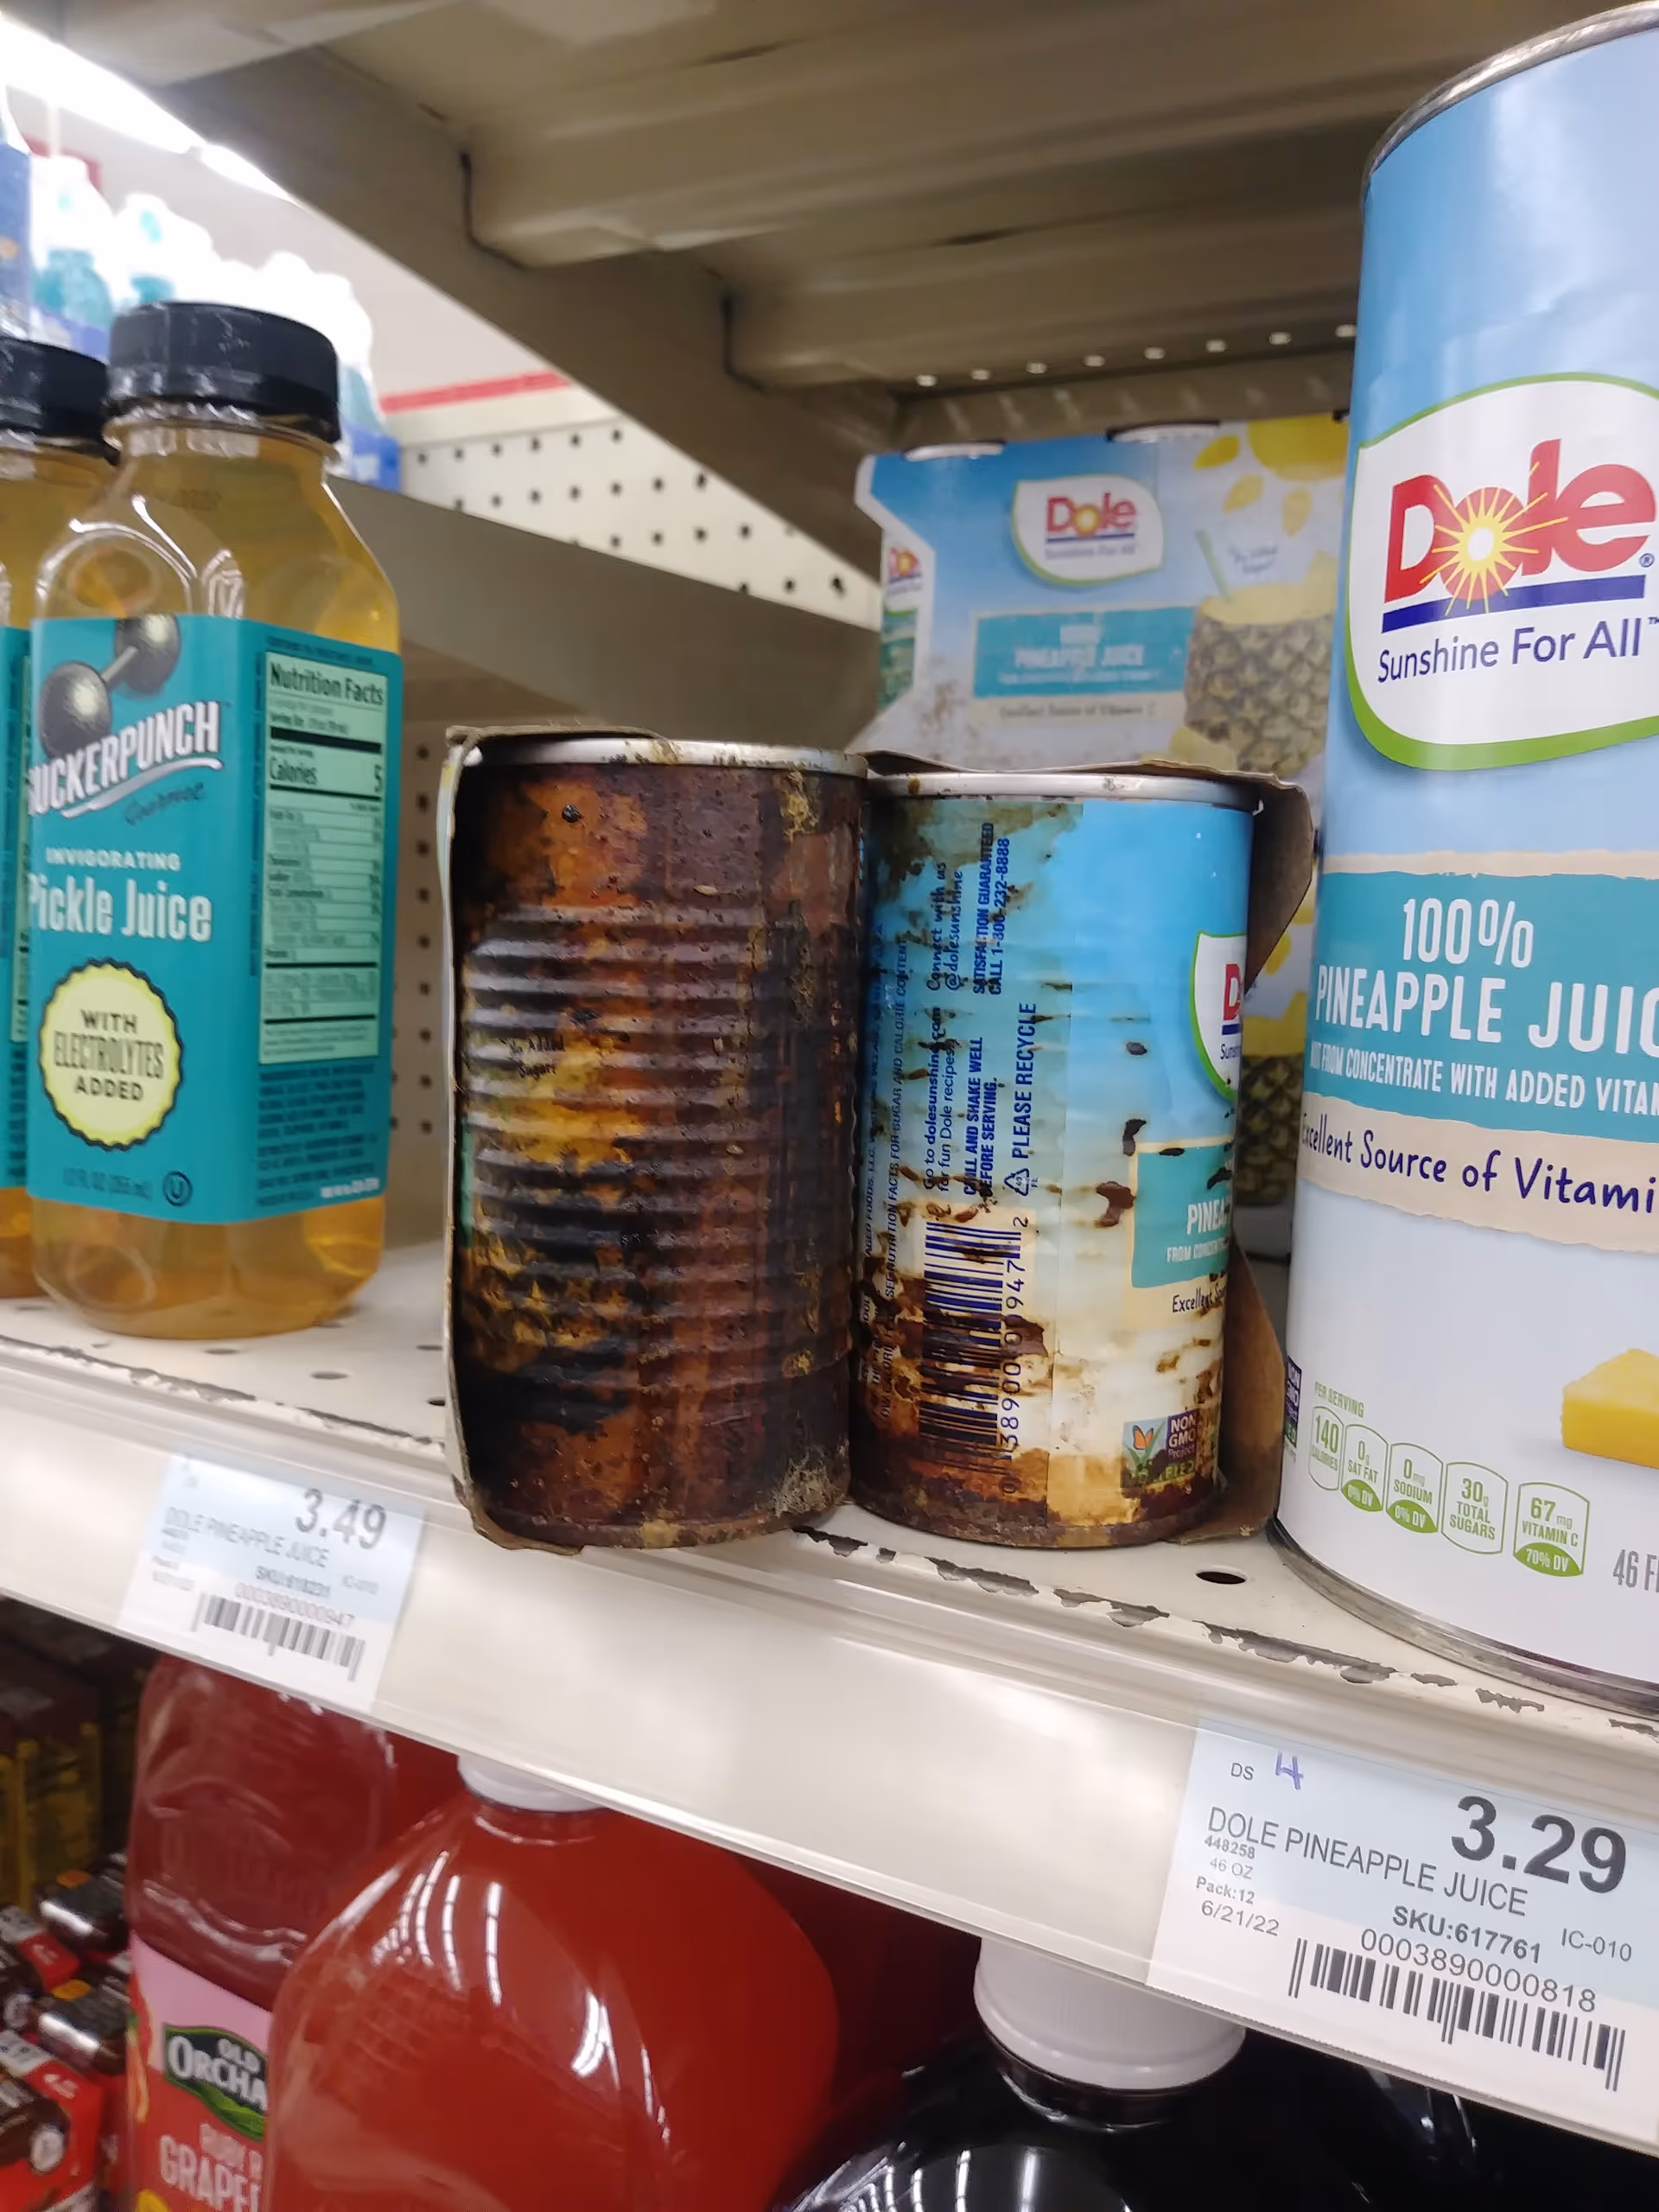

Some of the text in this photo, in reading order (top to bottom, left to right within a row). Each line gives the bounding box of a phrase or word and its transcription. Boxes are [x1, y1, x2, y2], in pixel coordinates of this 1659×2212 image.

[1046, 490, 1137, 537] Dole
[1384, 438, 1656, 603] Dole
[1377, 617, 1643, 683] Sunshine For All
[270, 661, 385, 706] Nutrition Facts
[270, 756, 383, 793] Calories 5
[46, 847, 181, 872] INVIGORATING
[121, 878, 213, 943] Juice
[925, 861, 947, 991] Connect with us
[943, 871, 963, 991] @dolesunshine
[1402, 898, 1535, 969] 100%
[988, 959, 1003, 995] CALL
[80, 1008, 138, 1034] WITH
[1314, 964, 1507, 1043] PINEAPPLE
[54, 1030, 165, 1080] ELECTROLYTES
[893, 1058, 905, 1084] AND
[968, 1036, 983, 1074] WELL
[73, 1075, 145, 1103] ADDED
[1011, 1001, 1037, 1160] PLEASE RECYCLE
[1321, 1043, 1344, 1077] FROM
[1345, 1047, 1444, 1093] CONCENTRATE
[1450, 1062, 1498, 1099] WITH
[1504, 1069, 1586, 1109] ADDED
[893, 1087, 903, 1132] SUGAR
[965, 1076, 982, 1122] SHAKE
[981, 1077, 999, 1141] SERVING.
[939, 1103, 953, 1141] Dole
[964, 1125, 979, 1156] AND
[890, 1134, 902, 1160] FOR
[924, 1147, 936, 1164] to
[938, 1142, 951, 1171] fun
[1301, 1112, 1353, 1163] Excellent
[1360, 1128, 1447, 1183] Source
[1461, 1149, 1502, 1192] of
[888, 1162, 901, 1202] FACTS
[938, 1172, 950, 1192] for
[1166, 1245, 1192, 1263] FROM
[1327, 1388, 1365, 1419] SERVING
[1168, 1427, 1198, 1448] GMO
[1171, 1414, 1197, 1433] NON
[1314, 1414, 1340, 1454] 140
[1348, 1459, 1379, 1484] SAT FAT
[1361, 1489, 1375, 1507] DV
[1394, 1478, 1433, 1505] SODIUM
[1529, 1497, 1556, 1522] 67
[294, 1487, 387, 1550] 3.49
[1395, 1504, 1427, 1529] 0% DV
[1449, 1514, 1497, 1541] SUGARS
[1456, 1500, 1491, 1524] TOTAL
[1522, 1520, 1580, 1548] VITAMIN C
[1526, 1548, 1570, 1573] 70% DV
[1611, 1548, 1659, 1593] 46 F
[1230, 1762, 1255, 1781] DS
[1203, 1834, 1256, 1859] 448258
[1207, 1806, 1529, 1916] DOLE PINEAPPLE JUICE
[1450, 1795, 1627, 1894] 3.29
[1209, 1857, 1255, 1880] 46 OZ
[1195, 1875, 1255, 1905] Pack:12
[1200, 1899, 1281, 1937] 6/21/22
[1391, 1905, 1633, 1965] SKU:617761 IC-010
[1360, 1928, 1597, 2013] 0003890000818
